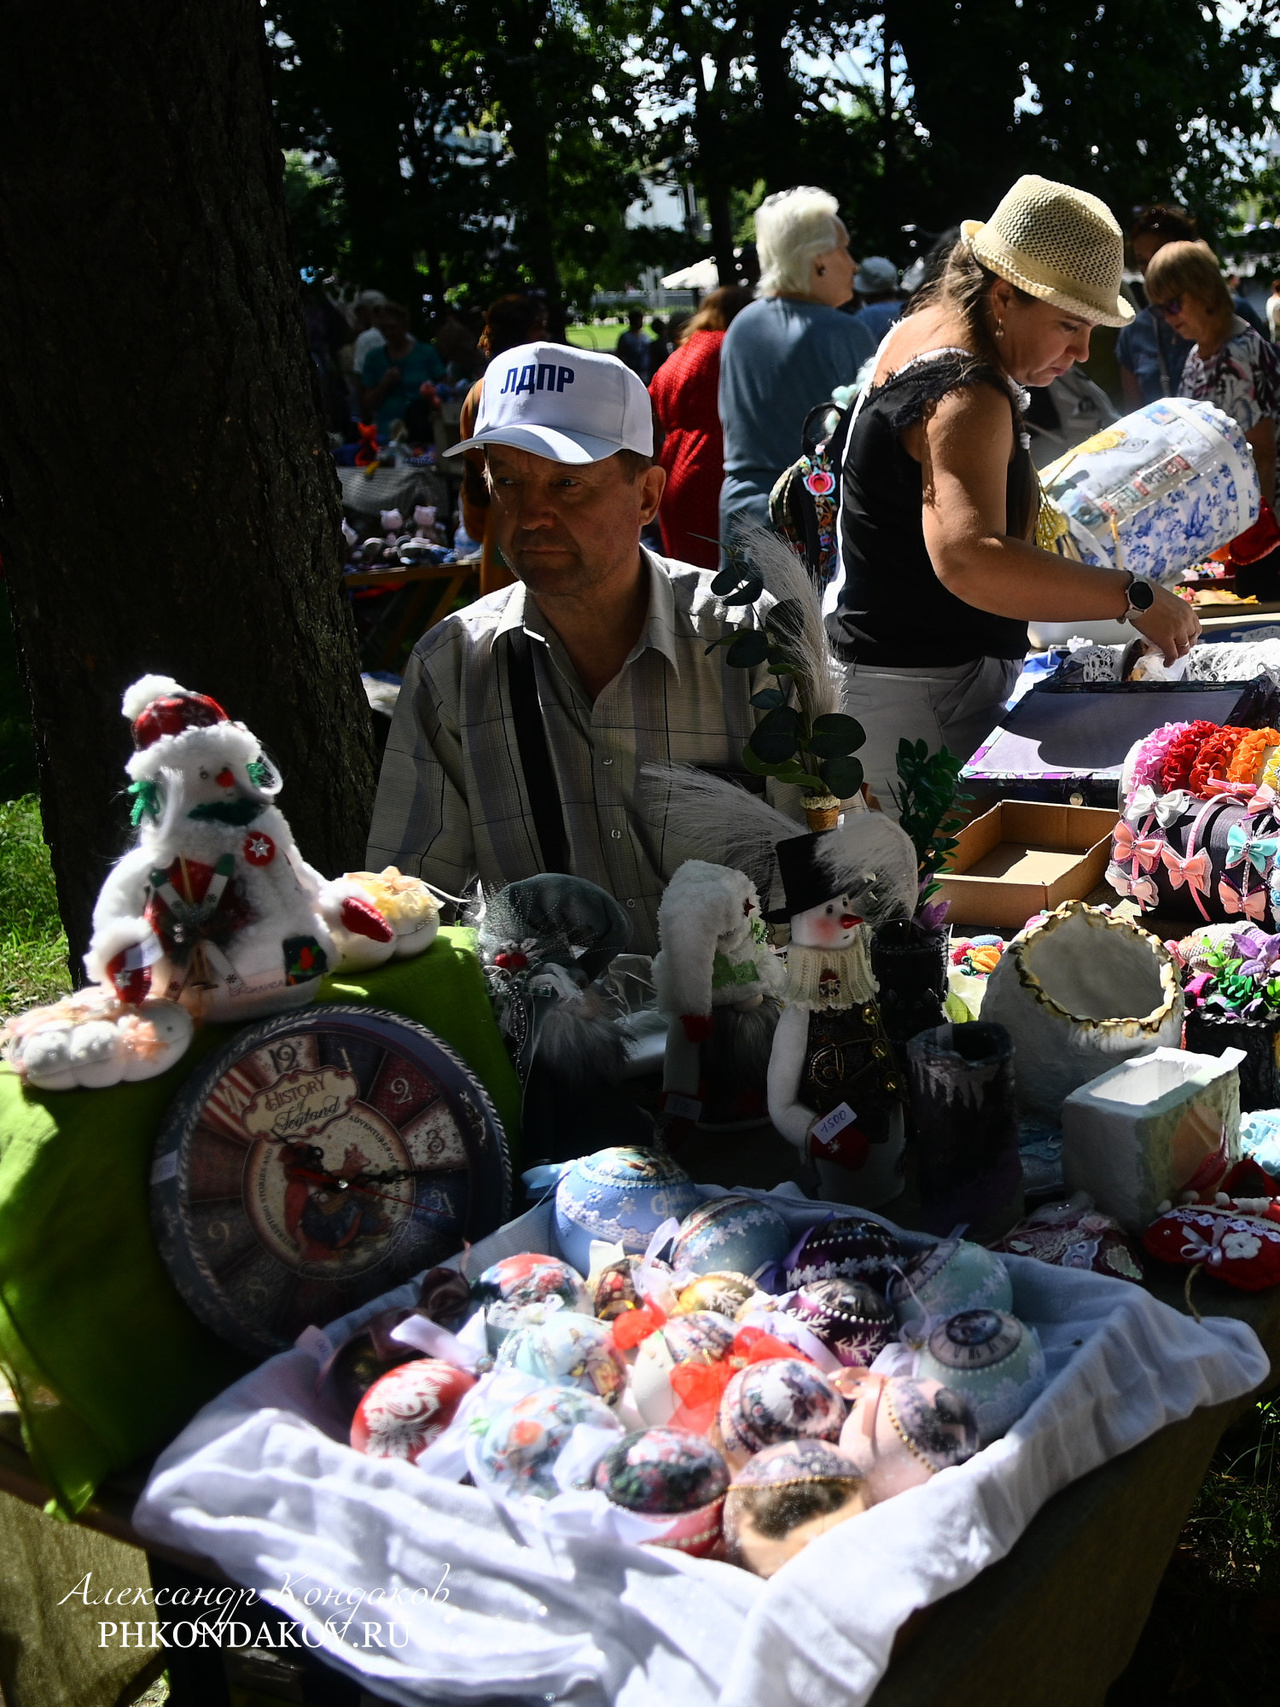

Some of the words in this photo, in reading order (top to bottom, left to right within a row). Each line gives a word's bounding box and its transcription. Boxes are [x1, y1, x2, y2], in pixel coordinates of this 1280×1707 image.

[500, 363, 575, 395] ЛДПР
[264, 1074, 325, 1111] HISTORY
[391, 1077, 413, 1105] 2
[820, 1109, 847, 1134] 1500
